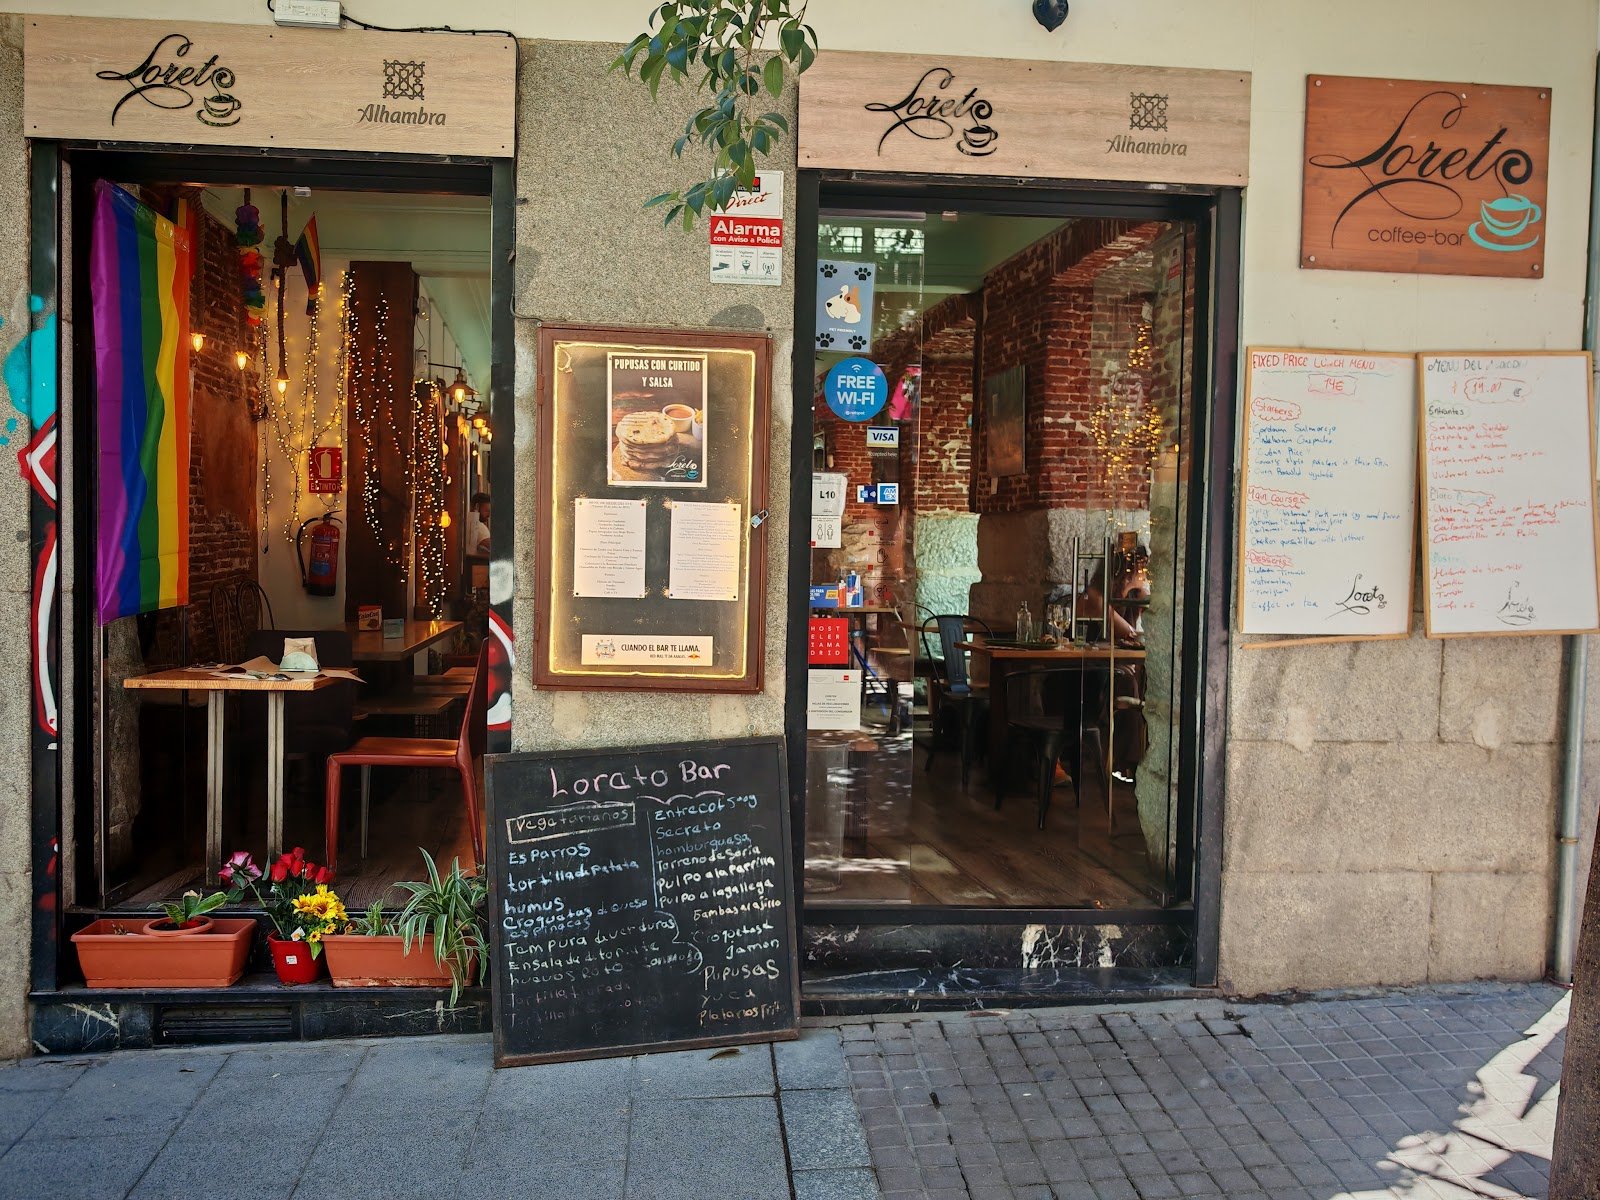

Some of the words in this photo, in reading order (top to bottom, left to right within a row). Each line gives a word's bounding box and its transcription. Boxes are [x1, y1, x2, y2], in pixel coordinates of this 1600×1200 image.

[96, 34, 236, 126] Loreto
[357, 104, 446, 126] Alhambra
[865, 67, 994, 156] Loreto
[1105, 134, 1188, 156] Alhambra
[1309, 91, 1533, 249] Loreto
[714, 219, 781, 237] Alarma
[1368, 227, 1465, 246] coffee-bar
[614, 358, 649, 370] PUPUSAS
[651, 359, 667, 371] CON
[668, 360, 701, 372] CURTIDO
[1253, 353, 1280, 368] FIXED
[1283, 353, 1309, 368] PRICE
[1350, 359, 1375, 370] MENU
[642, 376, 647, 387] Y
[649, 377, 673, 388] SALSA
[837, 375, 876, 389] FREE
[837, 391, 875, 406] WI-FI
[872, 432, 895, 442] VISA
[819, 490, 836, 499] L10
[620, 643, 648, 652] CUANDO
[648, 644, 655, 652] EL
[656, 644, 669, 652] BAR
[670, 644, 677, 652] TE
[678, 759, 731, 784] Bar
[504, 896, 565, 915] humus
